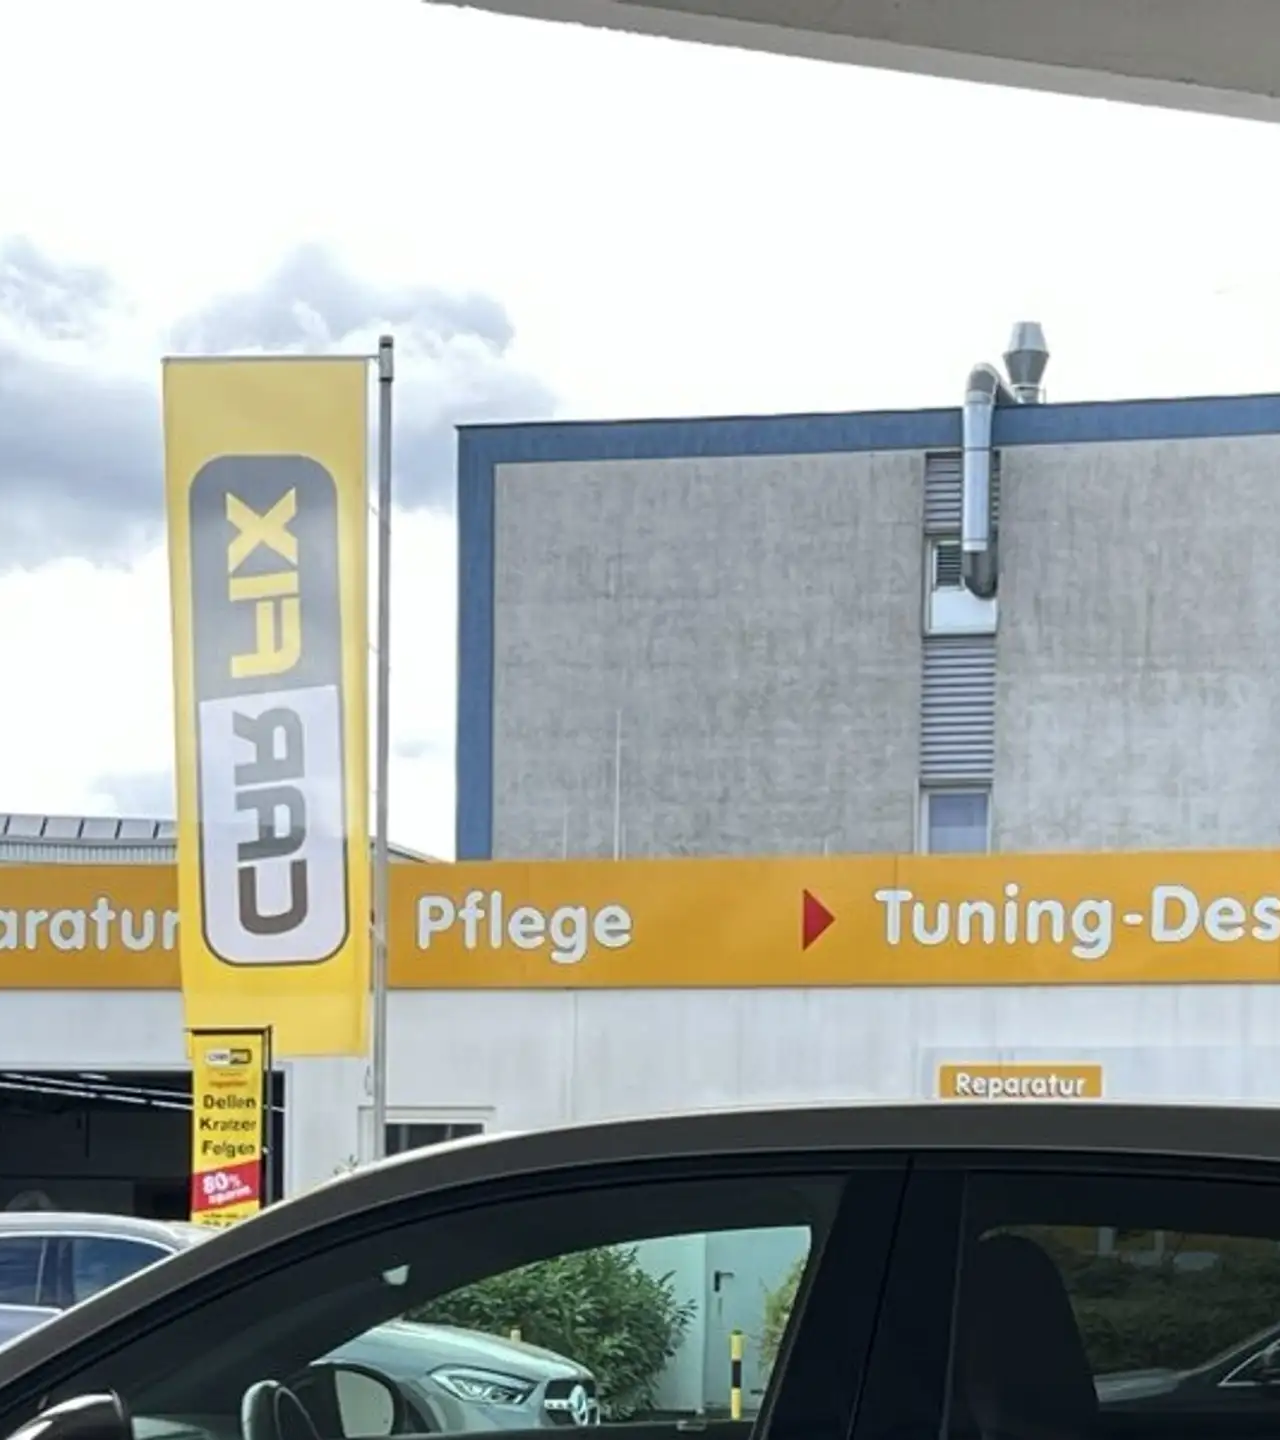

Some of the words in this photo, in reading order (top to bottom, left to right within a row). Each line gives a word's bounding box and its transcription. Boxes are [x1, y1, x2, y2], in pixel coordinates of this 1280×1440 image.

[417, 890, 633, 964] Pflege
[955, 1072, 1088, 1099] Reparatur
[202, 1094, 257, 1110] Dellen
[201, 1139, 256, 1159] Felgen
